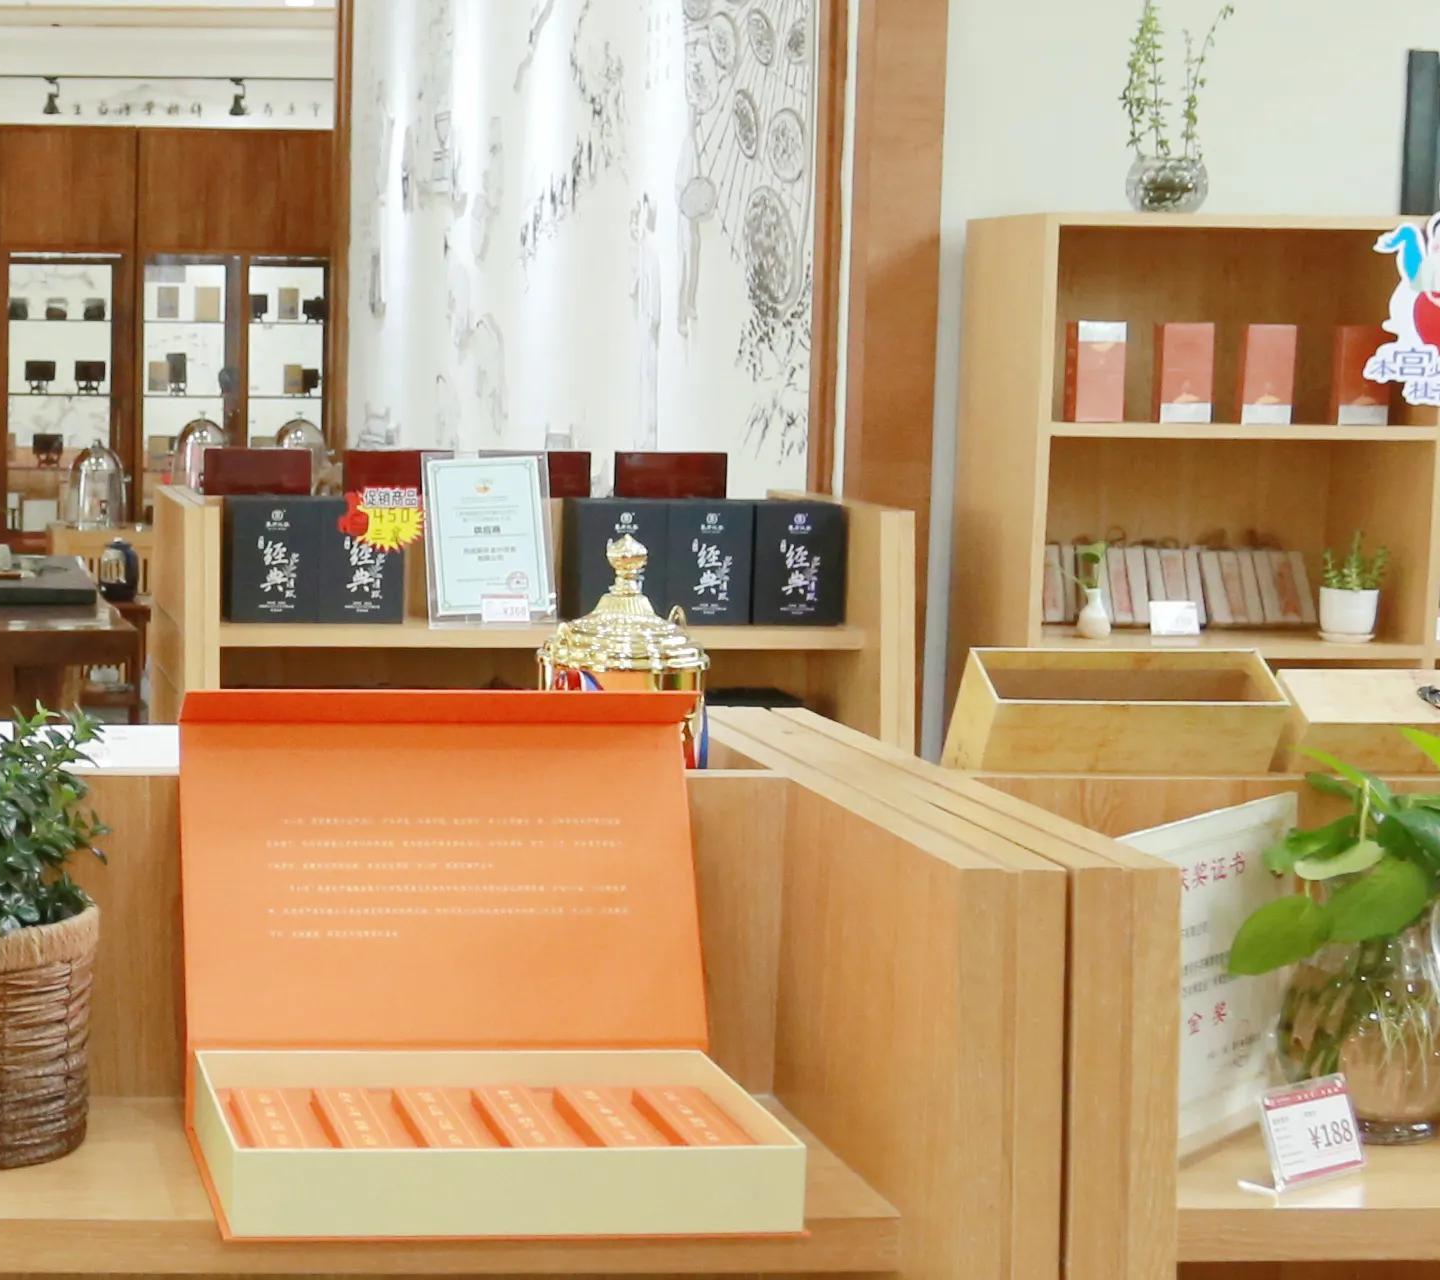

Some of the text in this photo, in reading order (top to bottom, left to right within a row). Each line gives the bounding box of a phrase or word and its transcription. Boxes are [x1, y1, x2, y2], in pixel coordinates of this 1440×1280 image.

[364, 489, 417, 507] 促销商品
[1188, 1001, 1227, 1036] 金奖
[1308, 1118, 1353, 1150] ¥188
